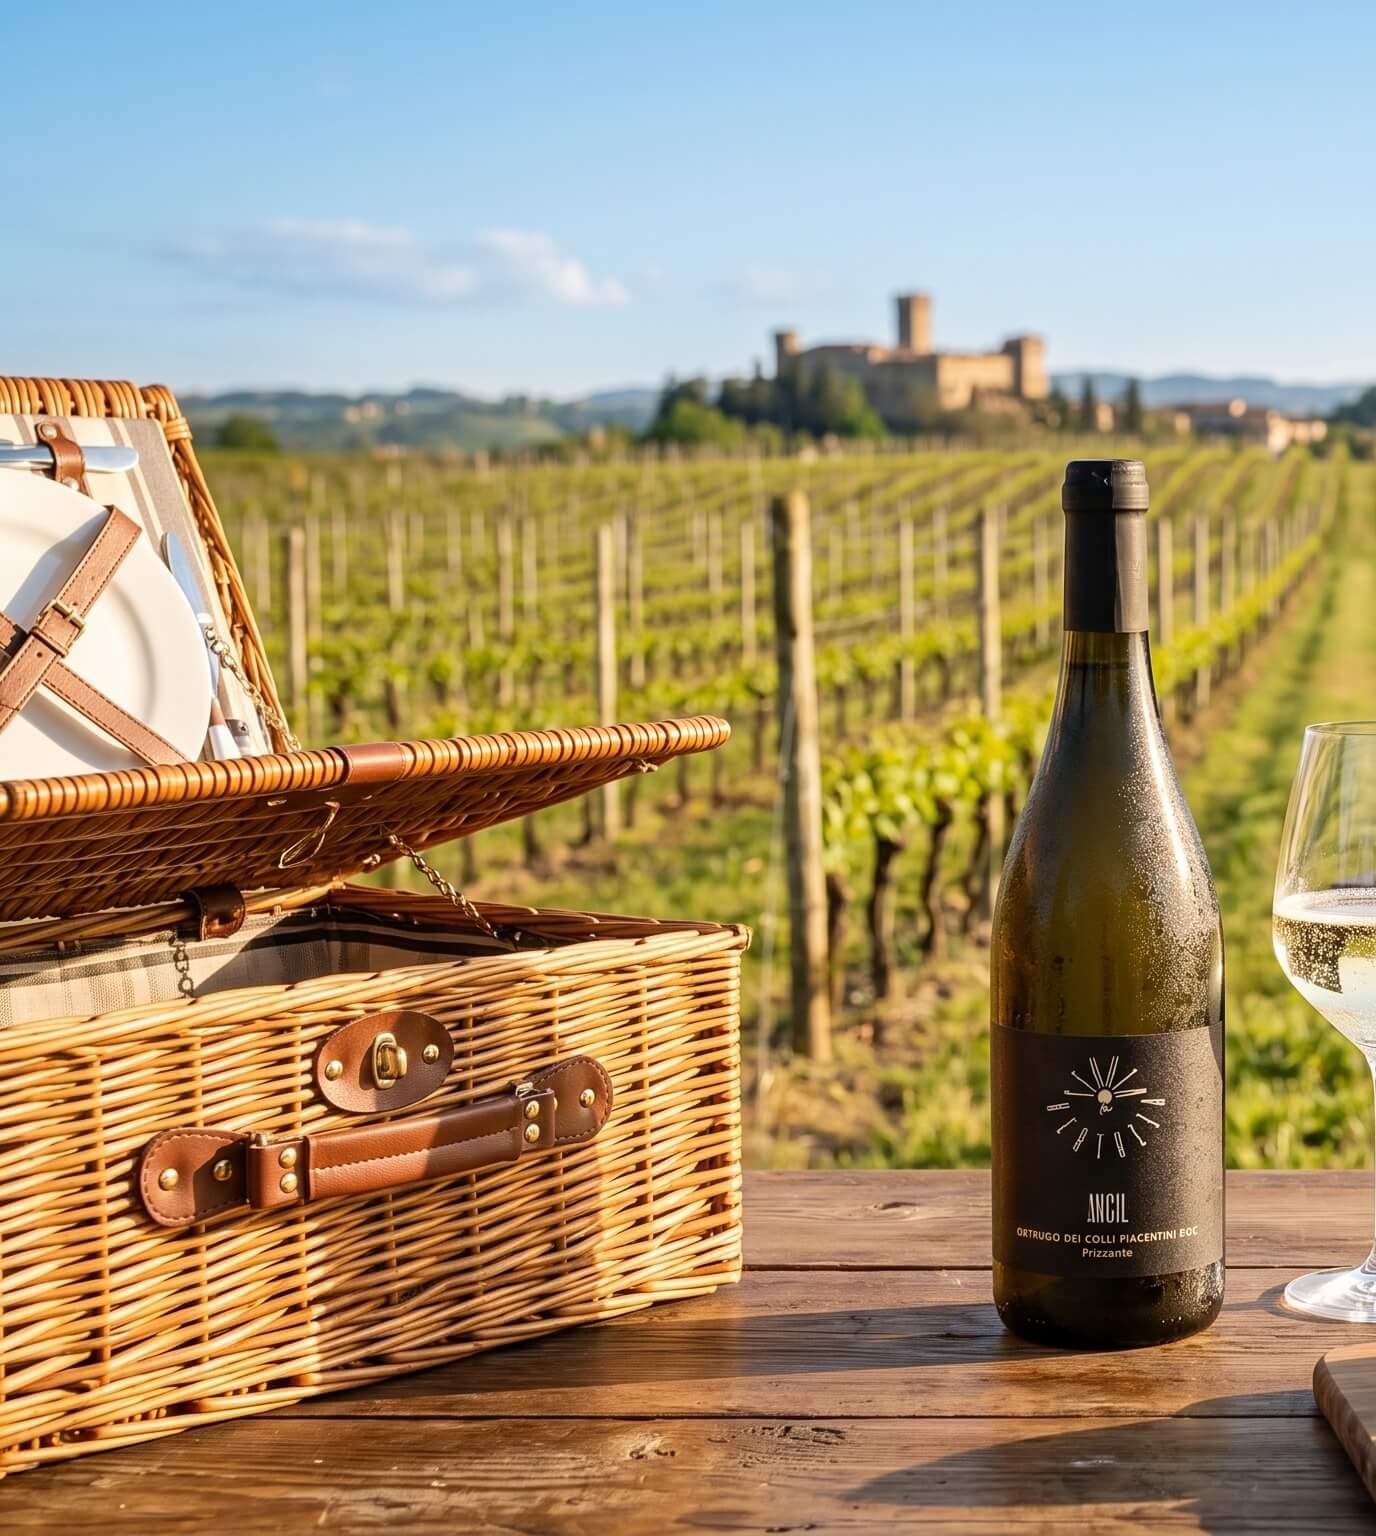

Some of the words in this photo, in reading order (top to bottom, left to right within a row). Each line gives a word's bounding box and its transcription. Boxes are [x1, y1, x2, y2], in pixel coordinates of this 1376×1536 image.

[1087, 1193, 1129, 1223] ANCIL
[1017, 1227, 1060, 1242] ORTRUGO
[1064, 1234, 1081, 1244] DEI
[1085, 1234, 1116, 1244] COLLI
[1119, 1230, 1177, 1244] PIACENTINI
